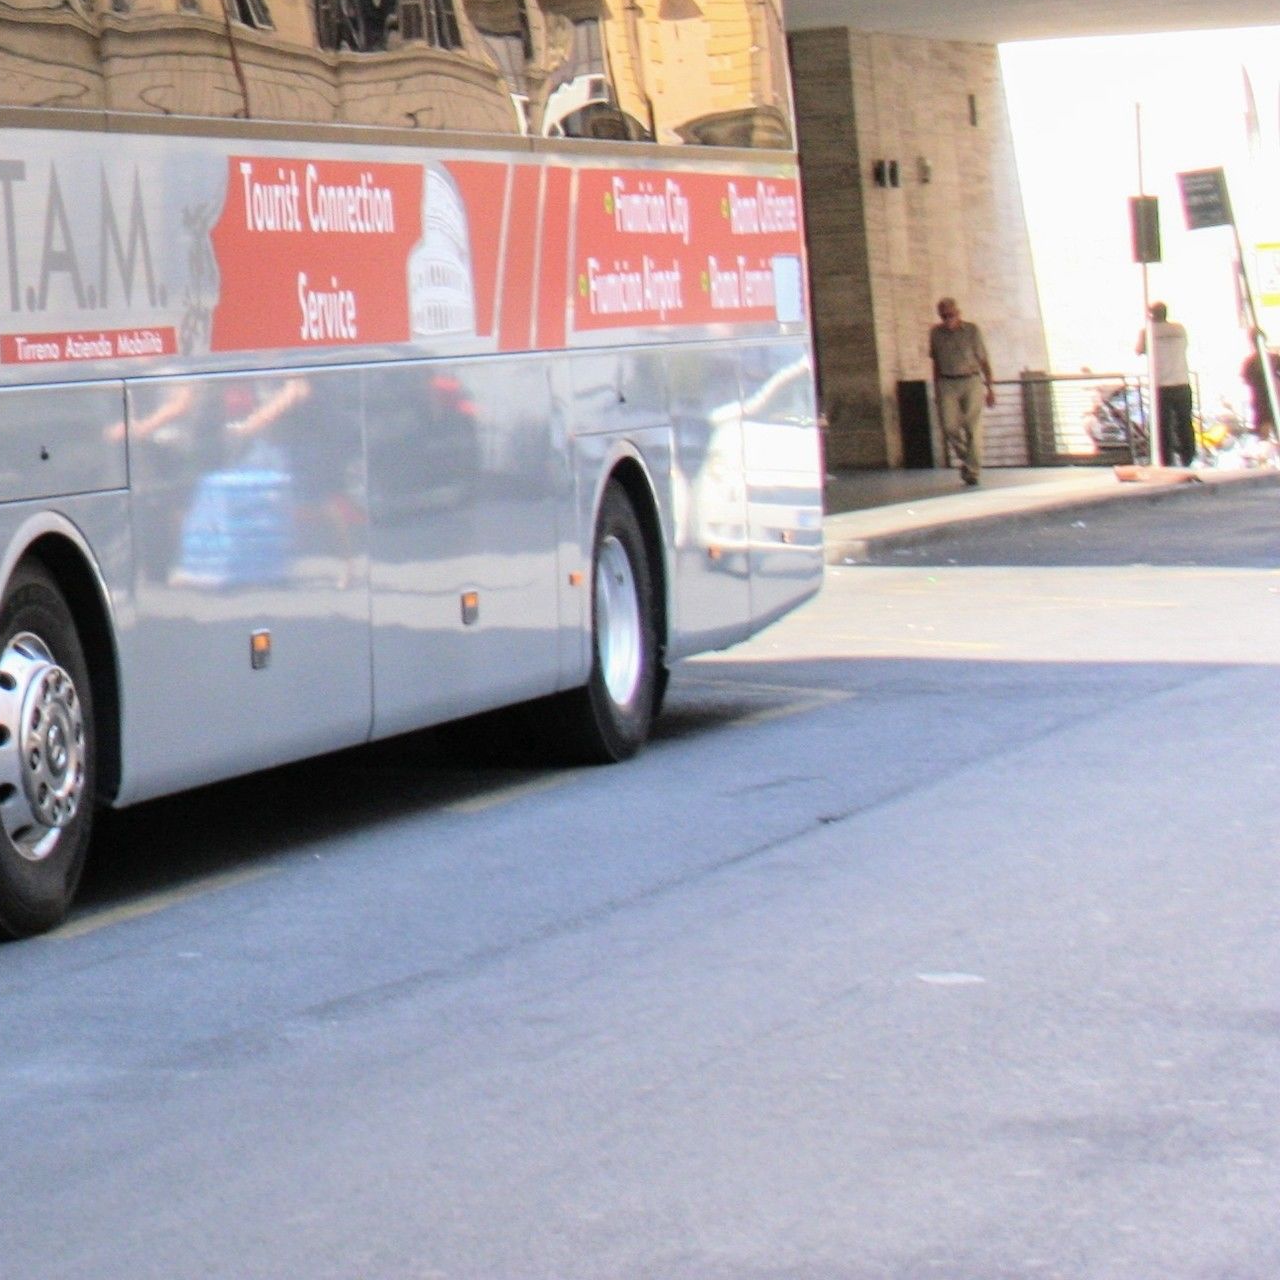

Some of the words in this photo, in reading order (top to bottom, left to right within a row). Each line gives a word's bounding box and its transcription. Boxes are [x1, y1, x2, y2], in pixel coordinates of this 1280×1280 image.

[240, 162, 302, 232] Tourist
[306, 163, 395, 234] Connection
[297, 271, 358, 341] Service
[65, 332, 113, 358] Azienda
